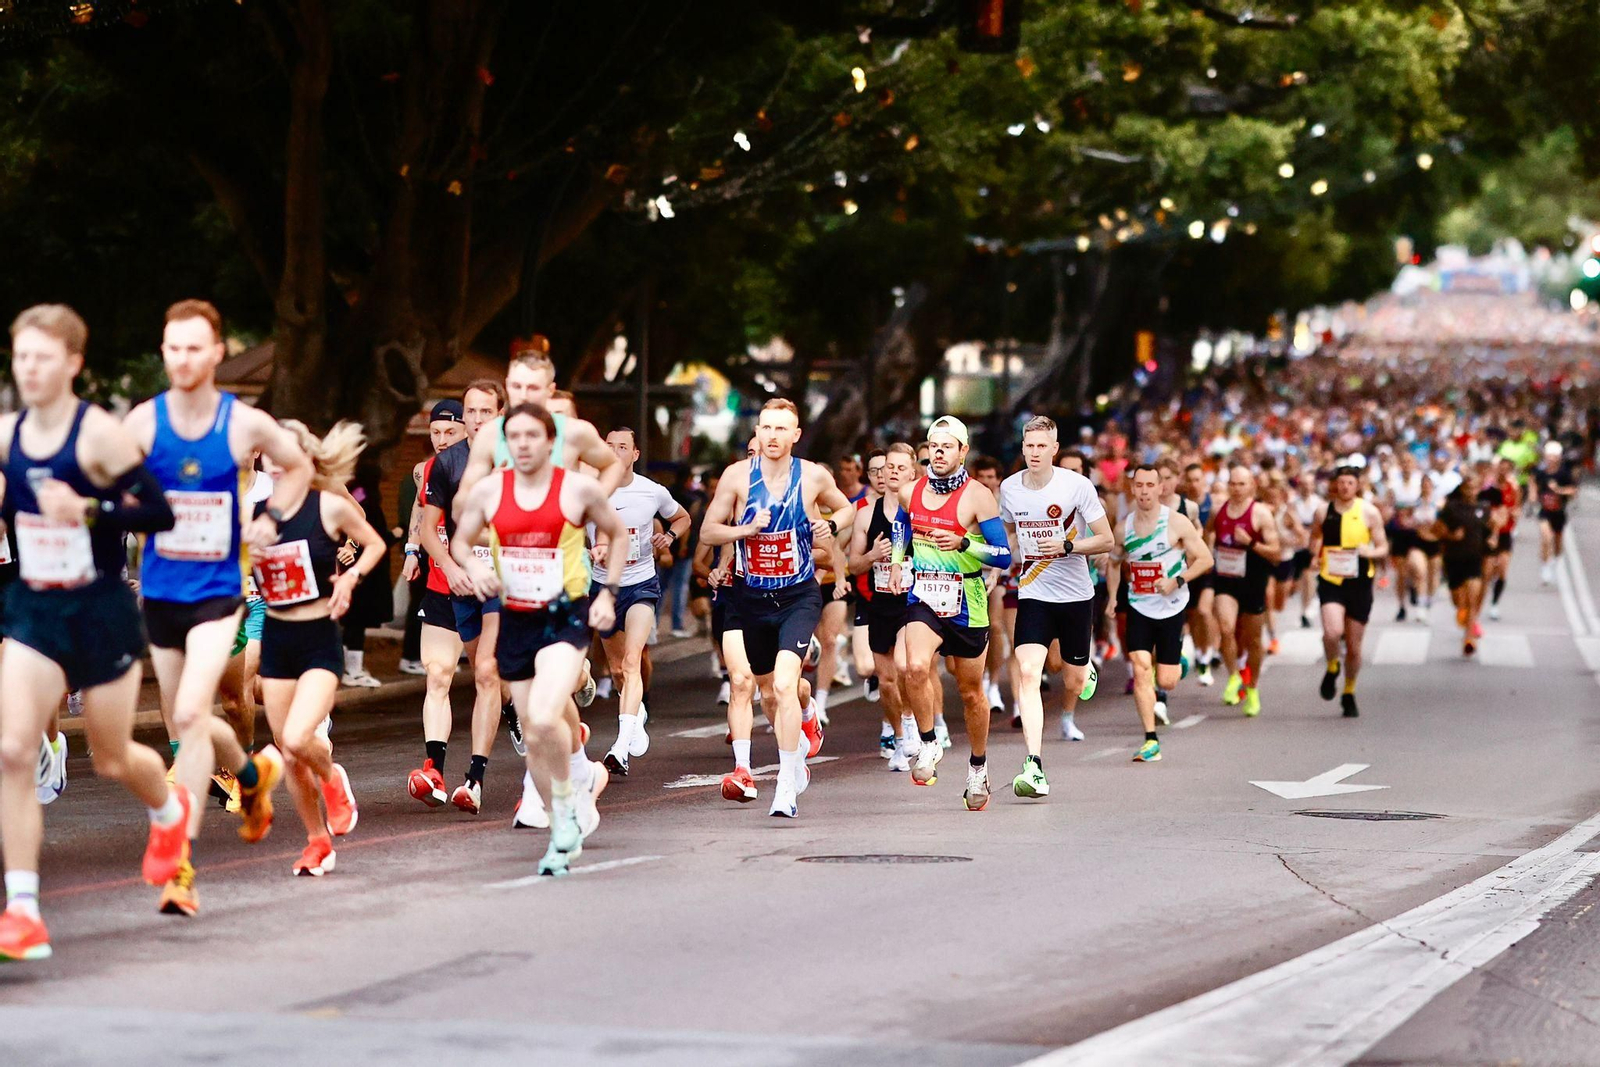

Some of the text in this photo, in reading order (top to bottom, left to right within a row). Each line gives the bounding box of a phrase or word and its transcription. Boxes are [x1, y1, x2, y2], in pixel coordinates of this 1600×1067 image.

[1026, 530, 1053, 539] 14600
[758, 544, 778, 553] 269
[923, 583, 950, 593] 15179
